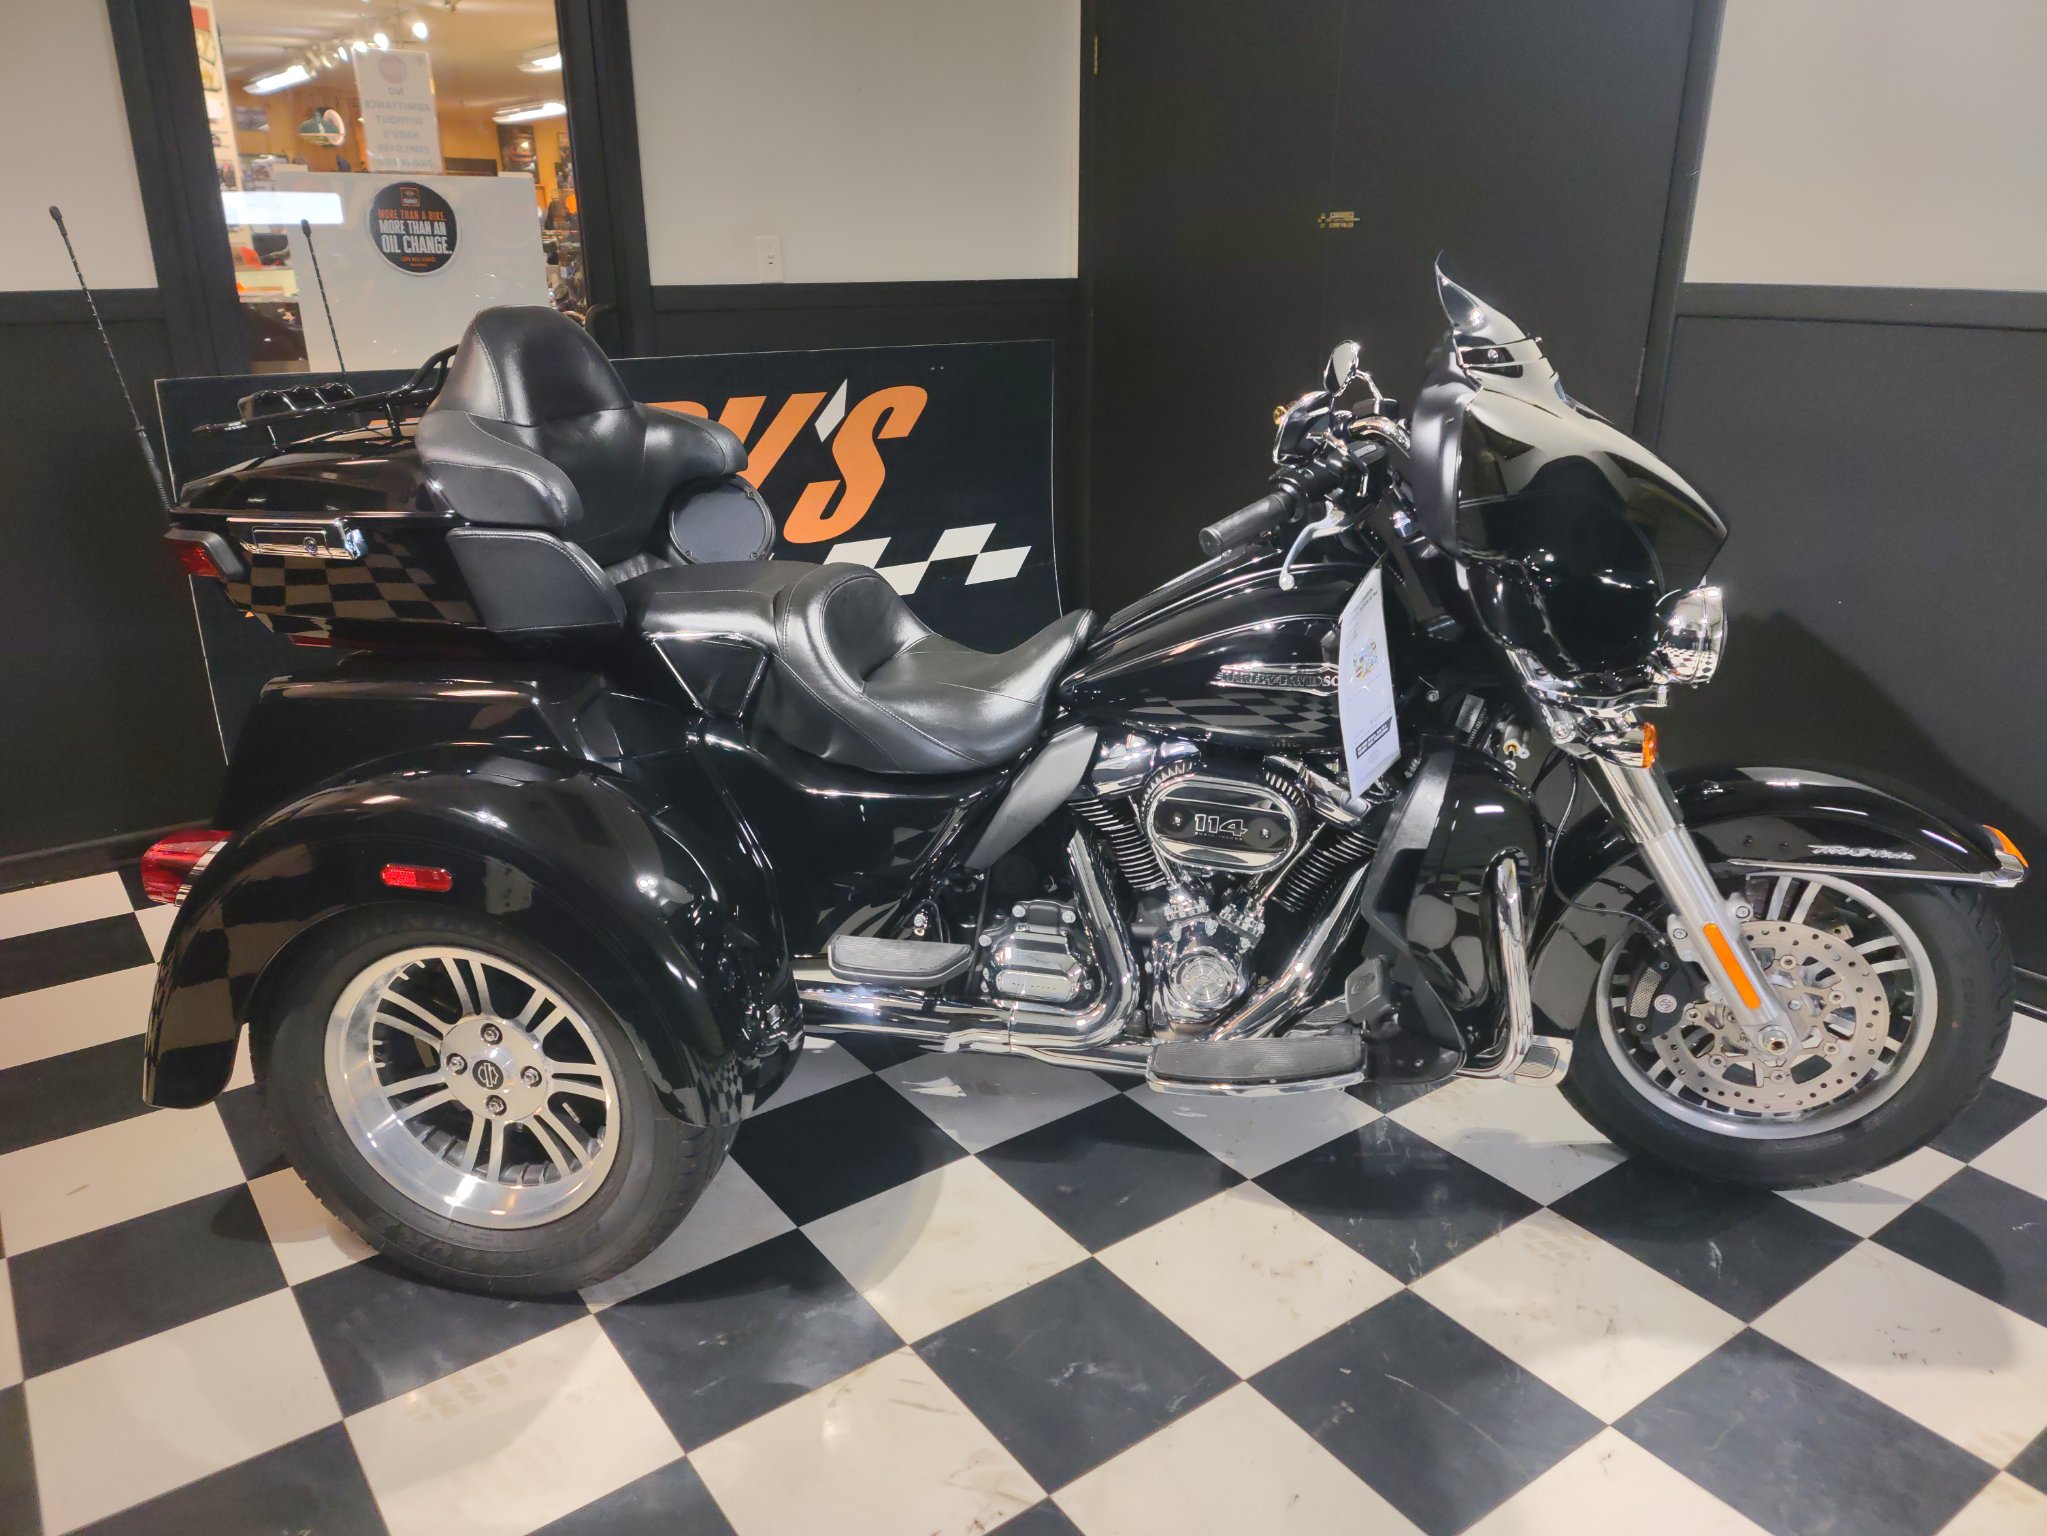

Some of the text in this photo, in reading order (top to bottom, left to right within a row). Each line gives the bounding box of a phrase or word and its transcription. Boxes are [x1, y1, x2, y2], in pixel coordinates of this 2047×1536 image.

[378, 210, 398, 219] MORE
[400, 209, 420, 220] THAN
[421, 211, 427, 220] A
[379, 220, 447, 235] MORE THAN AN
[382, 235, 453, 254] OIL CHANGE.
[1194, 813, 1248, 837] 114
